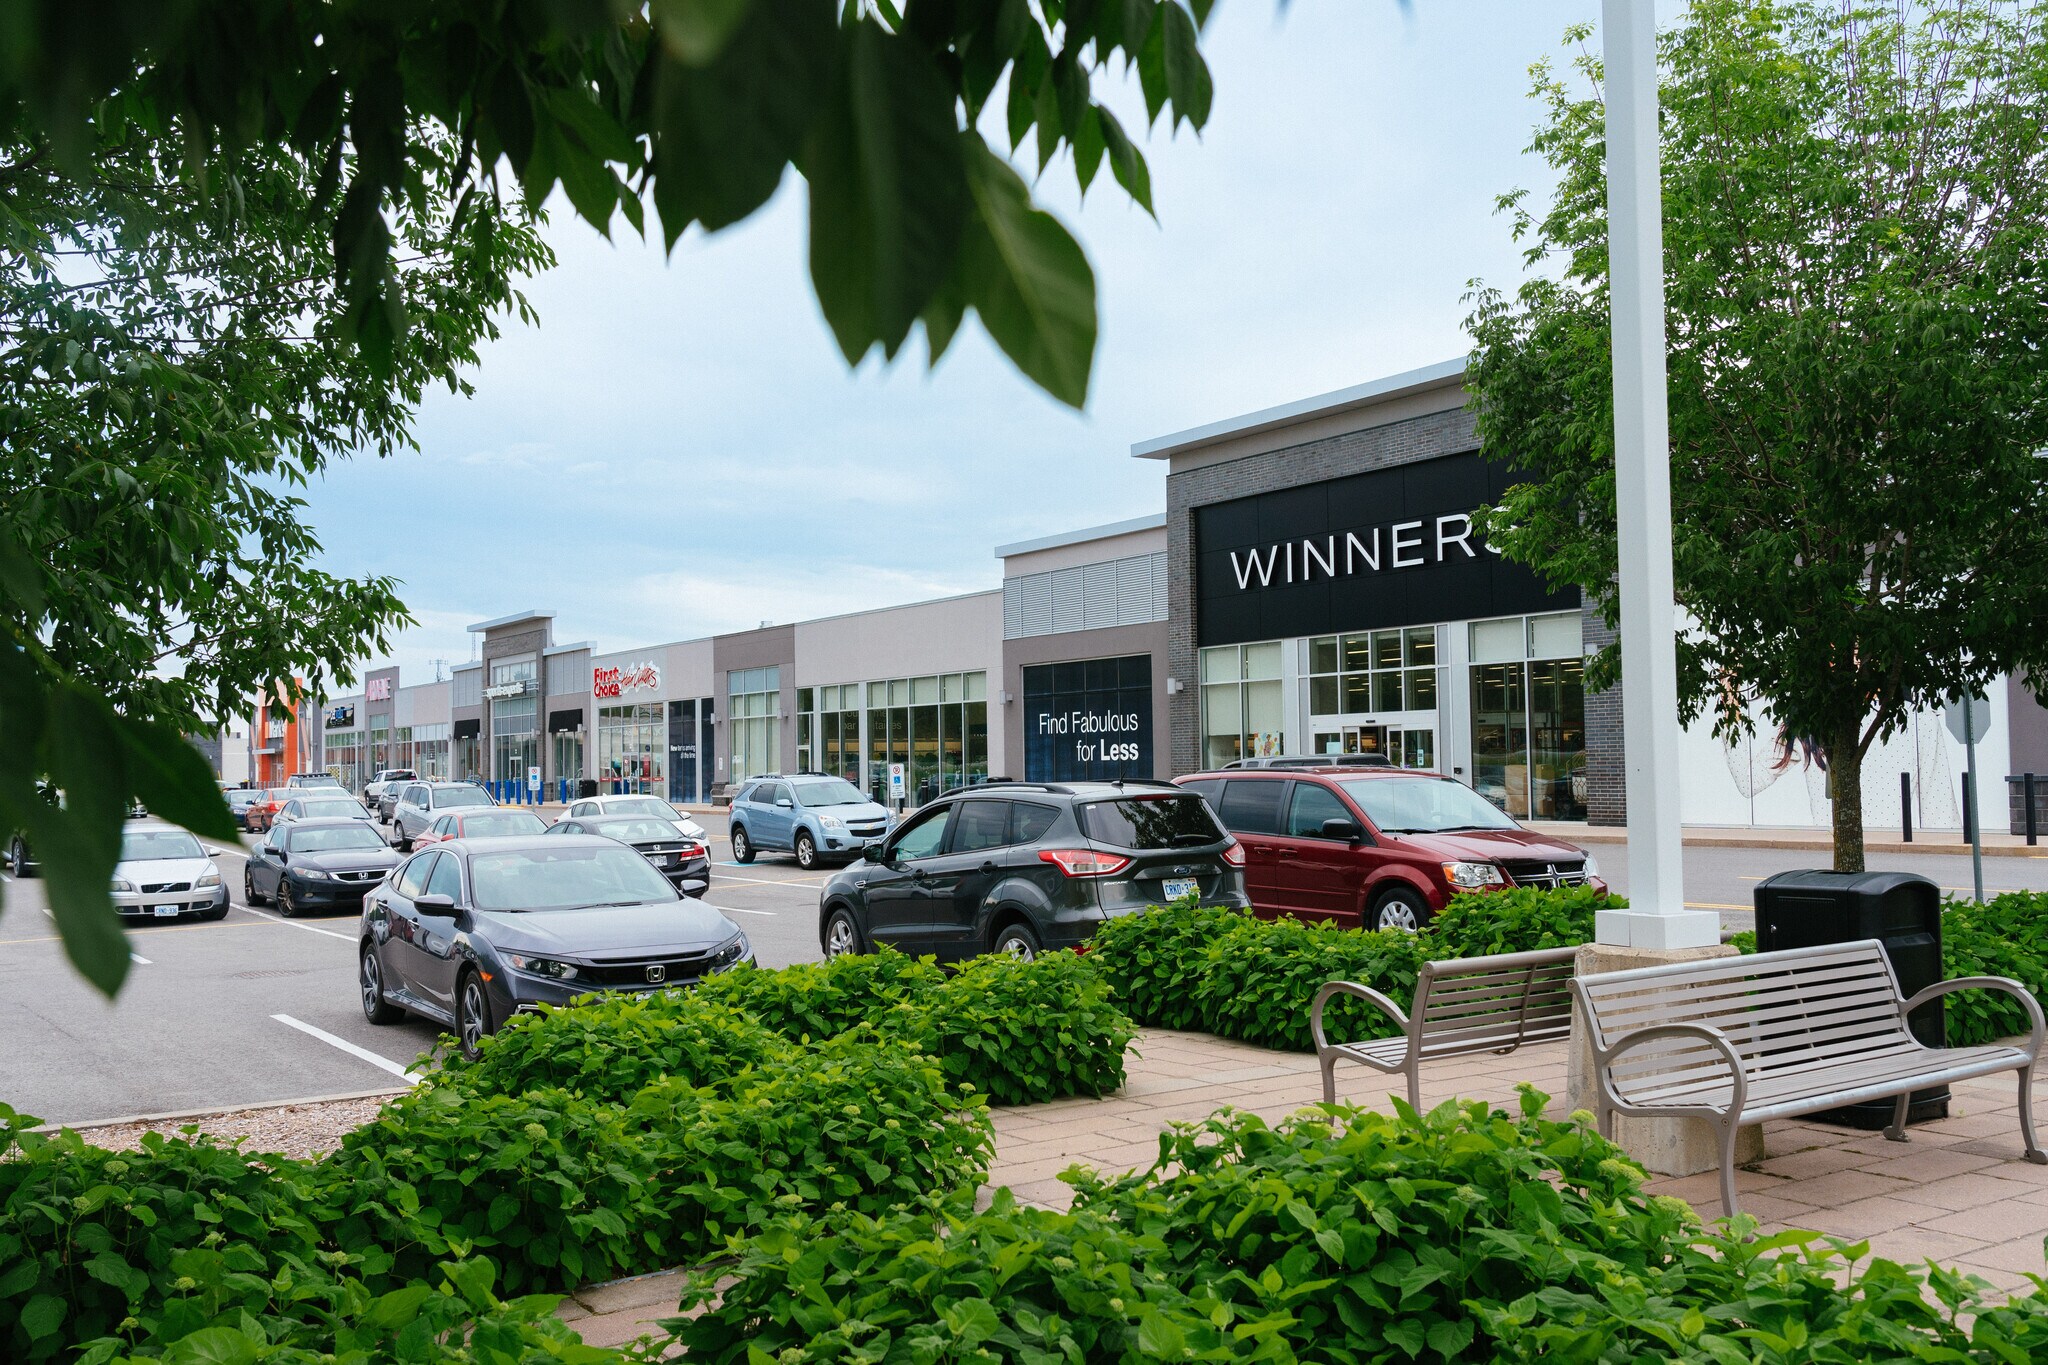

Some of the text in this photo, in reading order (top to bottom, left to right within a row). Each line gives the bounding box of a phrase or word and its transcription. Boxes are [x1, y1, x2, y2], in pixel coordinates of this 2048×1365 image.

[593, 666, 619, 683] First
[593, 682, 620, 698] Choice
[1039, 709, 1139, 735] Find Fabulous
[1076, 738, 1140, 762] for Less
